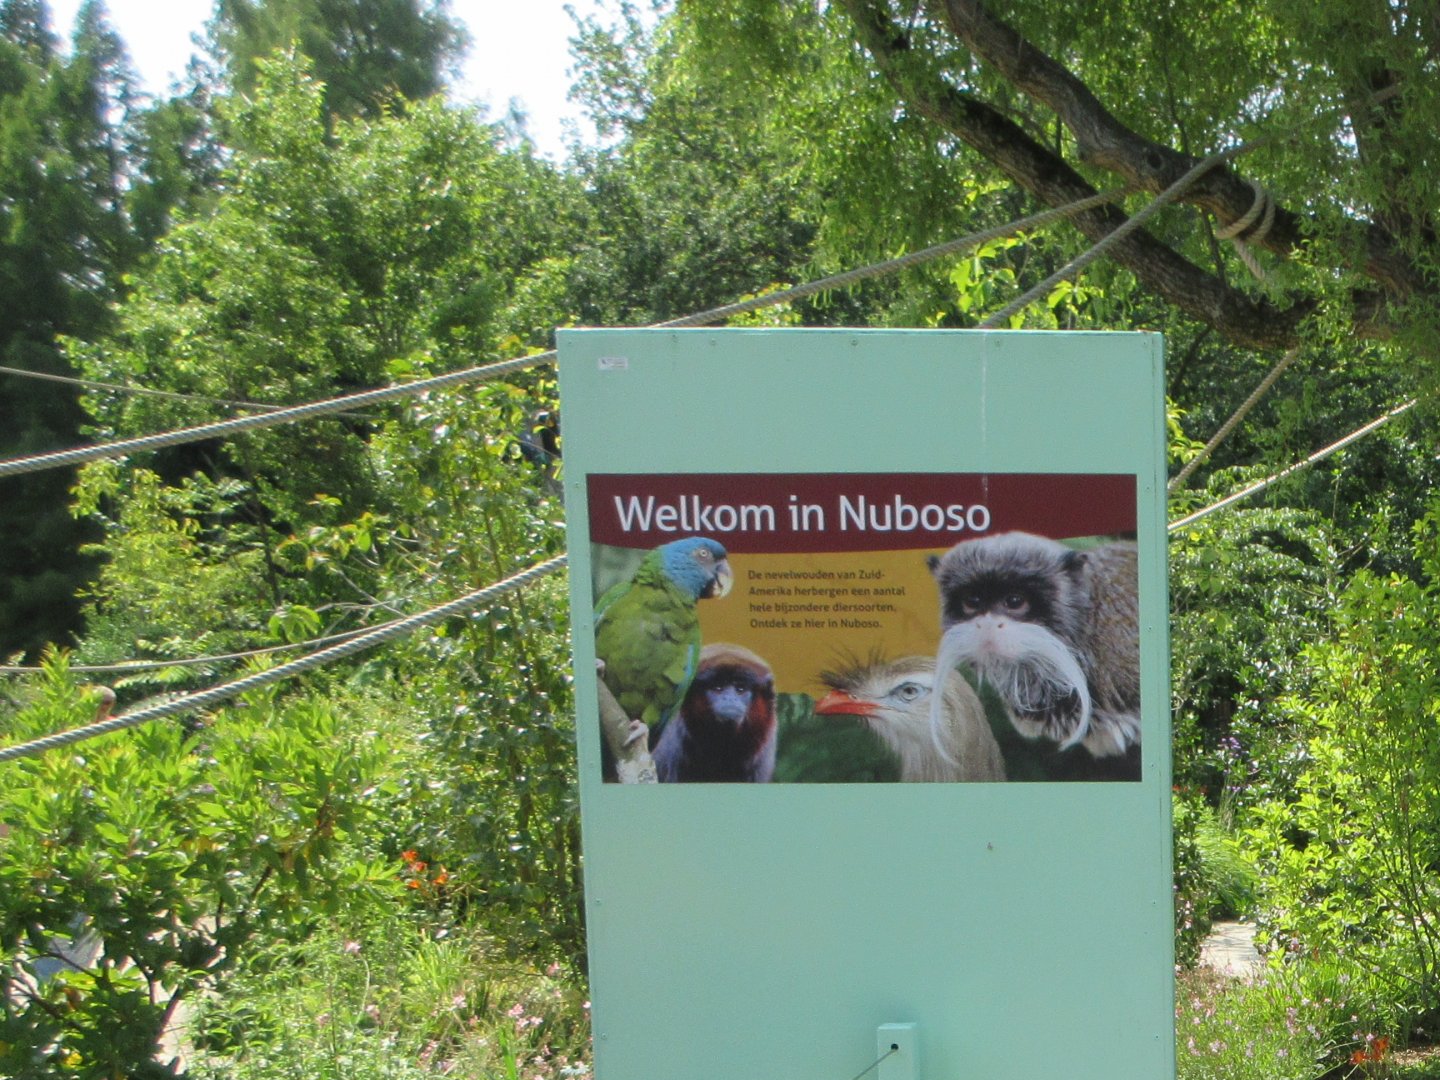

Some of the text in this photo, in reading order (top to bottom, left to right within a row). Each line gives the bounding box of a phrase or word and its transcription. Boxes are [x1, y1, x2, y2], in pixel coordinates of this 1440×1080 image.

[613, 494, 991, 532] Welkom in Nuboso
[748, 570, 885, 580] De nevelwouden van Zuid-
[749, 586, 905, 598] Amerika herbergen een aantal
[750, 602, 771, 612] hele
[775, 602, 829, 614] bijzondere
[750, 618, 883, 628] Ontdek ze hier in Nuboso.
